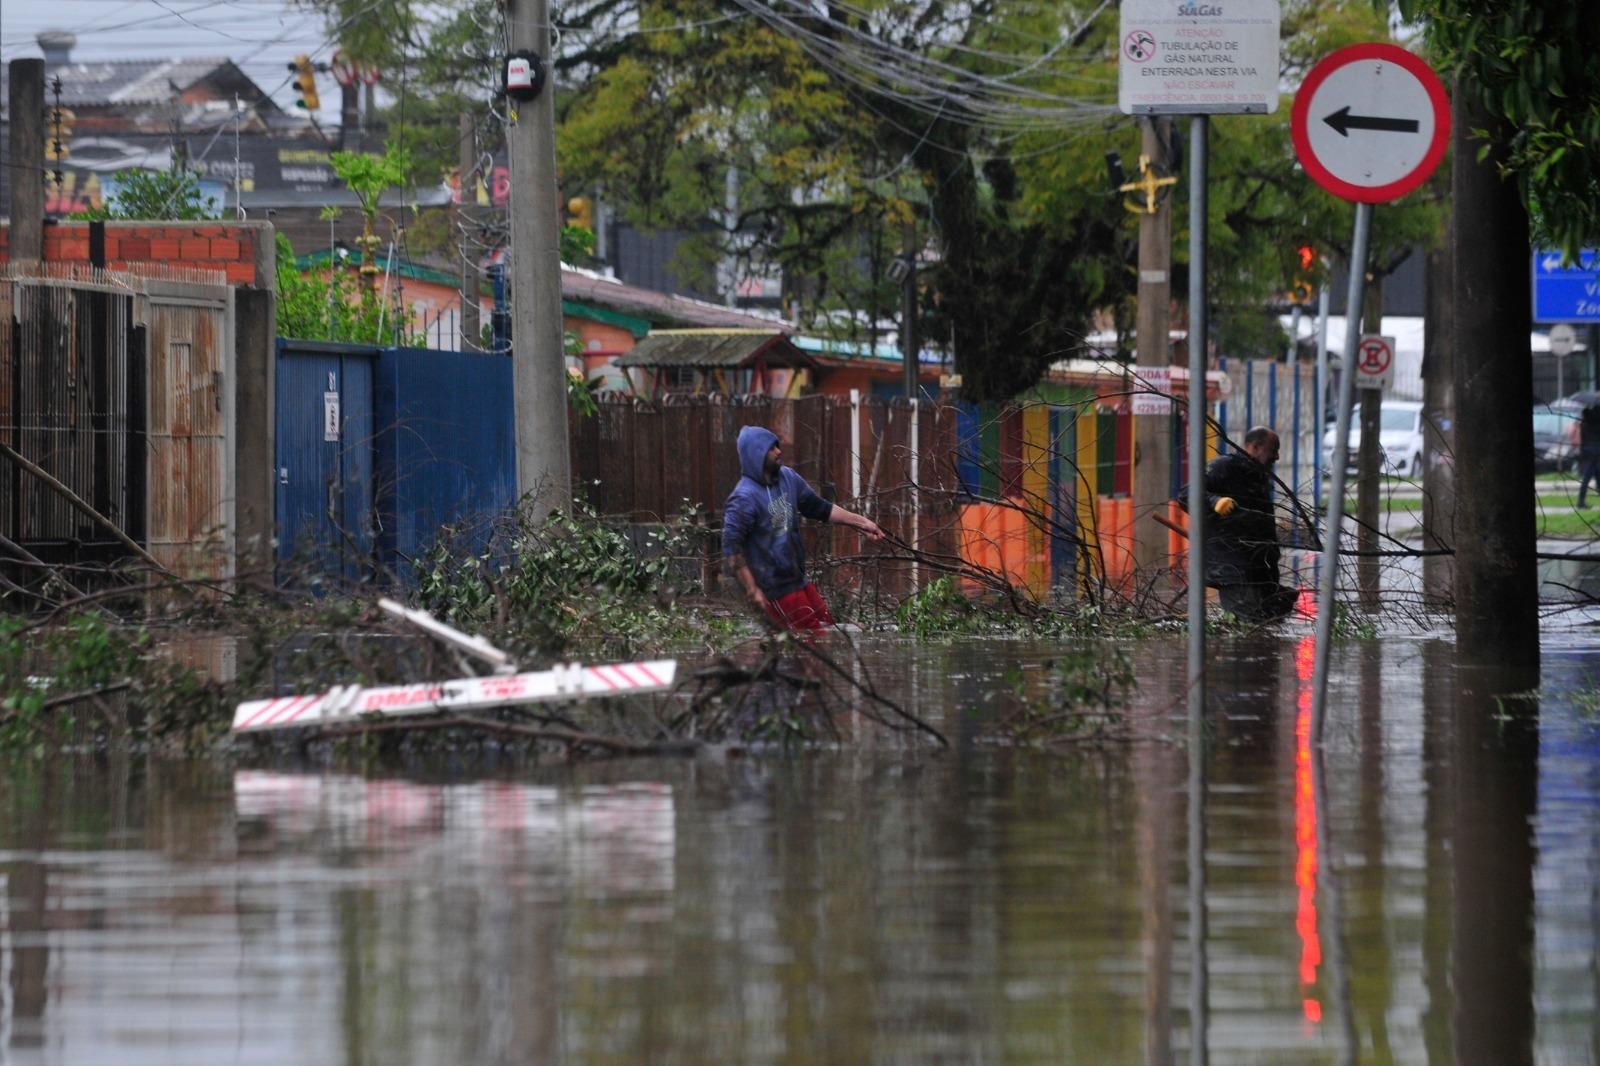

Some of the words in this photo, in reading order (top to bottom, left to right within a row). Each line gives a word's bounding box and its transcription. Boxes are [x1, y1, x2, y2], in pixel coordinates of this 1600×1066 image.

[1175, 28, 1223, 39] ATENÇÃO
[1160, 40, 1222, 52] TUBULAÇÃO
[1224, 41, 1239, 51] DE
[1188, 54, 1235, 64] NATURAL
[1141, 67, 1203, 77] ENTERRADA
[1205, 67, 1239, 77] NESTA
[1241, 67, 1257, 76] VIA
